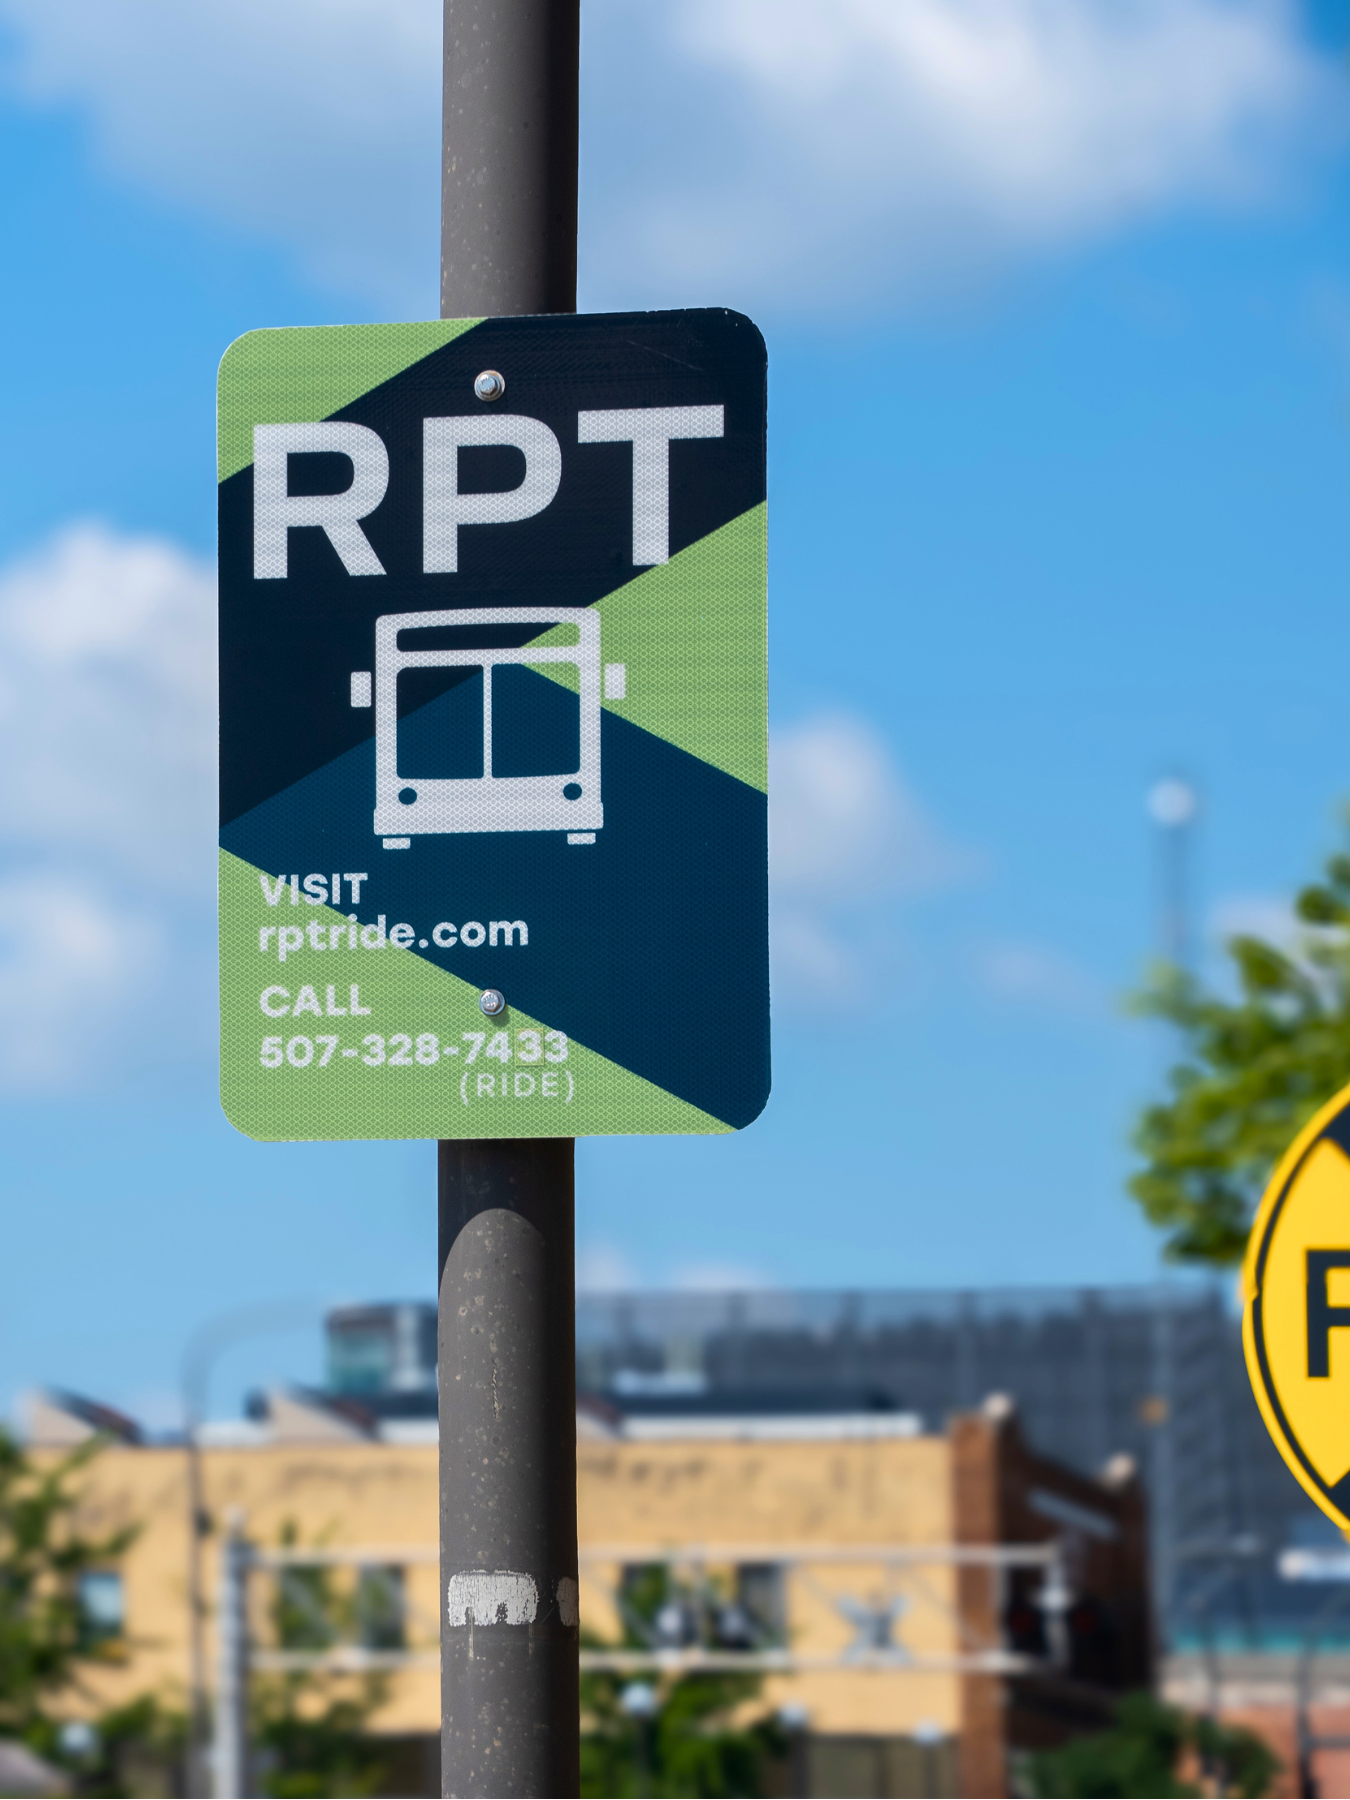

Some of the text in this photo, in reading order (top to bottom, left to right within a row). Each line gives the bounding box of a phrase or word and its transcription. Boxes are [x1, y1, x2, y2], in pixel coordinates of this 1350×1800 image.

[253, 404, 725, 580] RPT
[259, 872, 368, 906] VISIT
[259, 914, 529, 962] rptride.com
[259, 984, 372, 1018] CALL
[259, 1030, 569, 1068] 507-328-7433
[460, 1070, 575, 1106] (RIDE)
